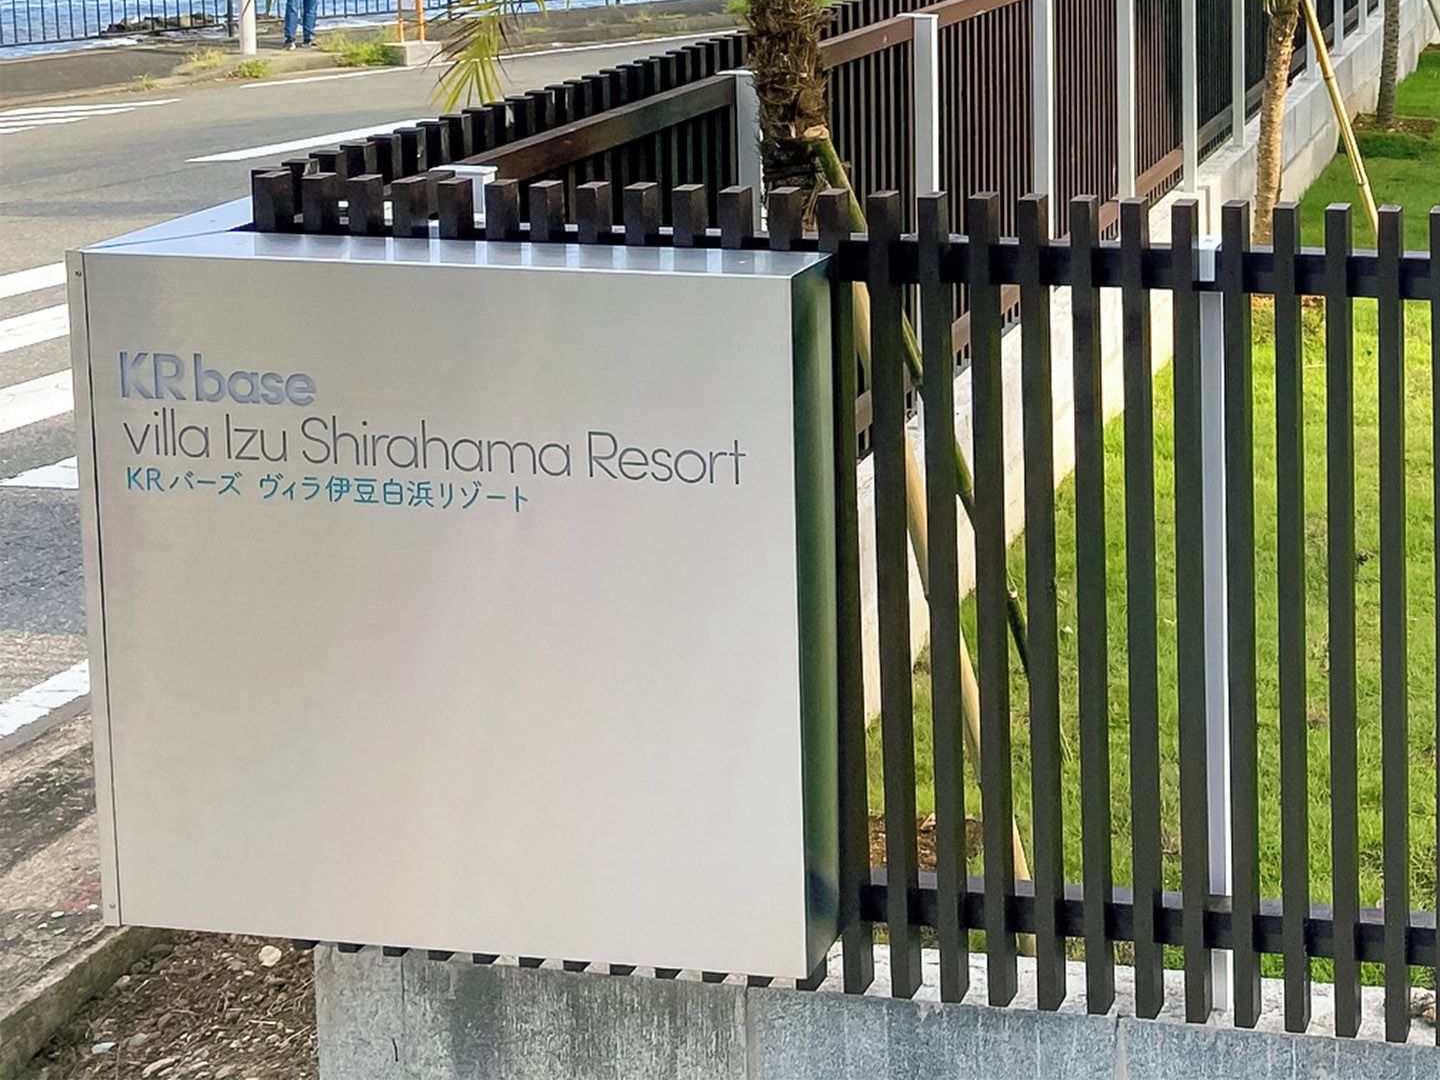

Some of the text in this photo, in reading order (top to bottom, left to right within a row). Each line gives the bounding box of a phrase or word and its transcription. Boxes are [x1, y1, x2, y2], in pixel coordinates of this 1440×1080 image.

[119, 351, 317, 407] KR base
[123, 407, 747, 485] villa Izu Shirahama Resort
[259, 473, 529, 513] ヴィラ伊豆白浜リゾート
